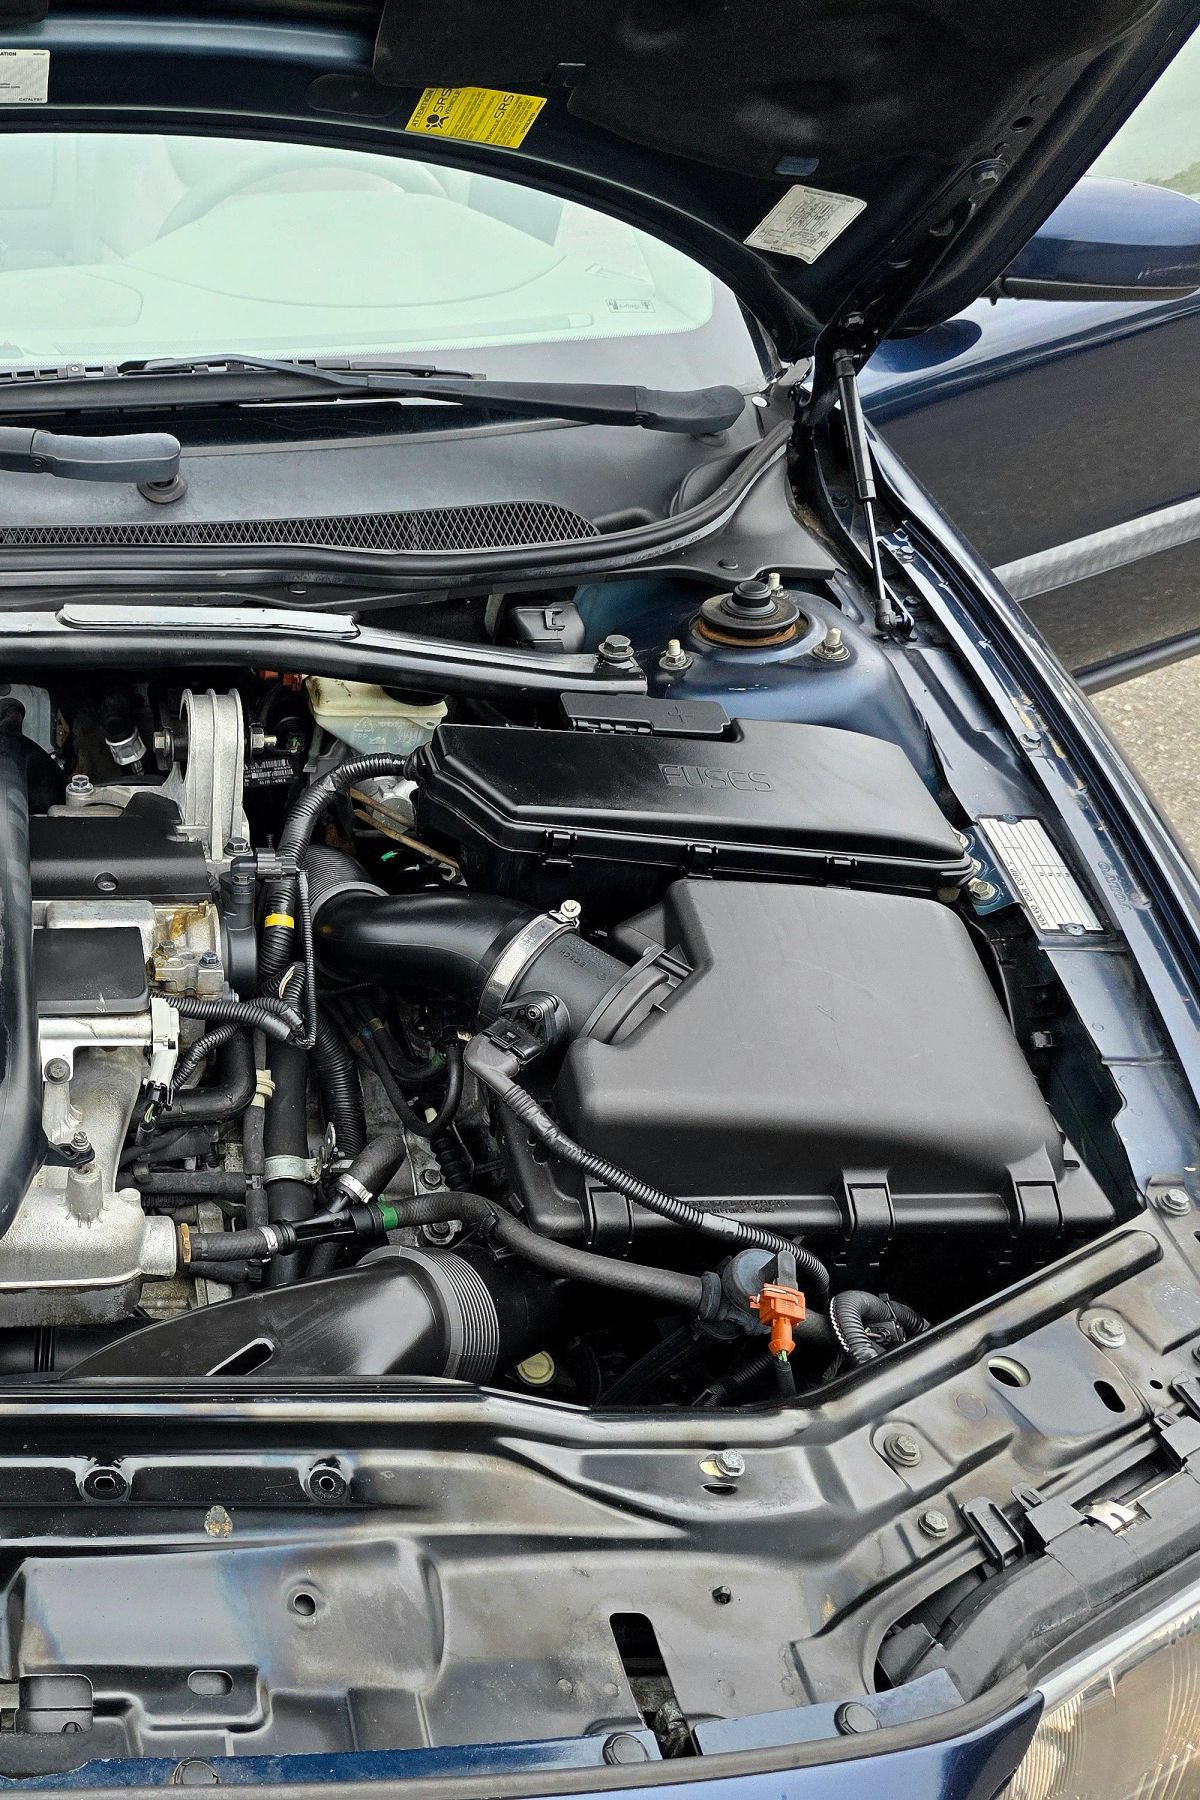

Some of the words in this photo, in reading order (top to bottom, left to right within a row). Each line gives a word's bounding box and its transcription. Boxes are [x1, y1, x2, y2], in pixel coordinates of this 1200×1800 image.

[433, 88, 452, 113] SRS
[494, 94, 514, 119] SRS
[658, 764, 775, 793] FUSES
[1030, 904, 1047, 927] VOLVO
[559, 950, 587, 969] BOSCH
